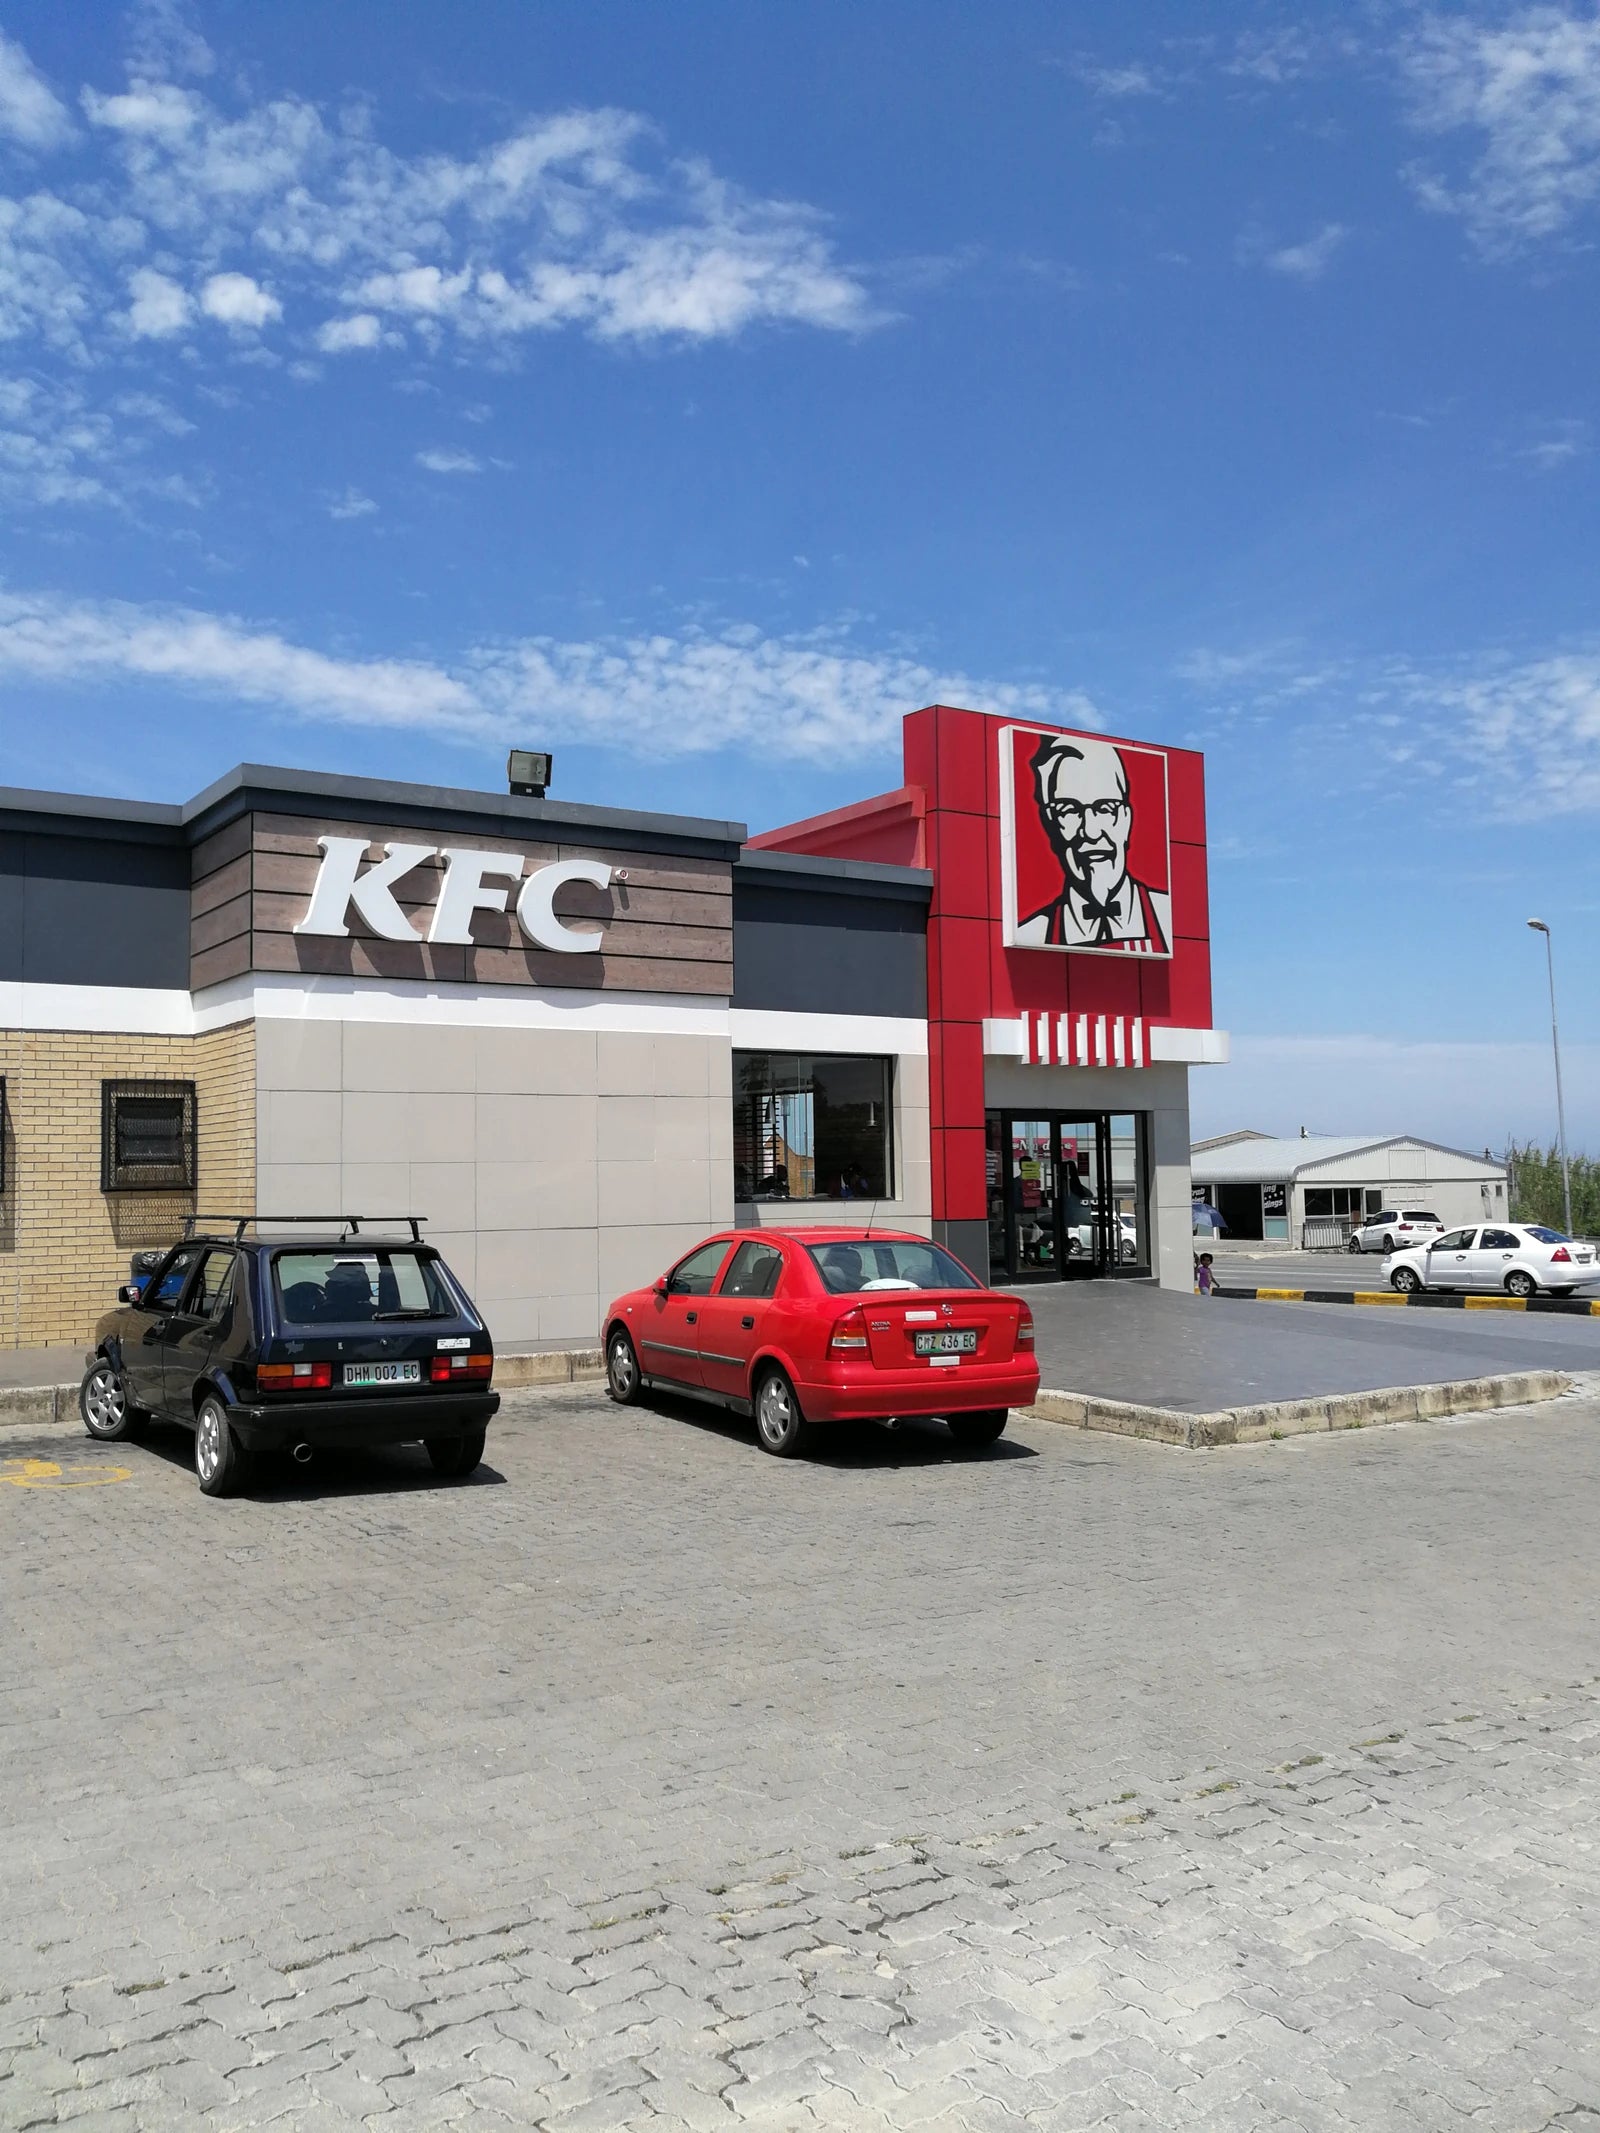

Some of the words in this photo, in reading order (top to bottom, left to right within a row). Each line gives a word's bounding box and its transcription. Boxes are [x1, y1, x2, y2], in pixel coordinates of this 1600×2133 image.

[293, 835, 613, 954] KFC
[941, 1335, 959, 1349] 436
[963, 1334, 975, 1348] EC
[346, 1366, 370, 1382] DHM
[375, 1365, 397, 1380] 002
[403, 1364, 418, 1379] EC
